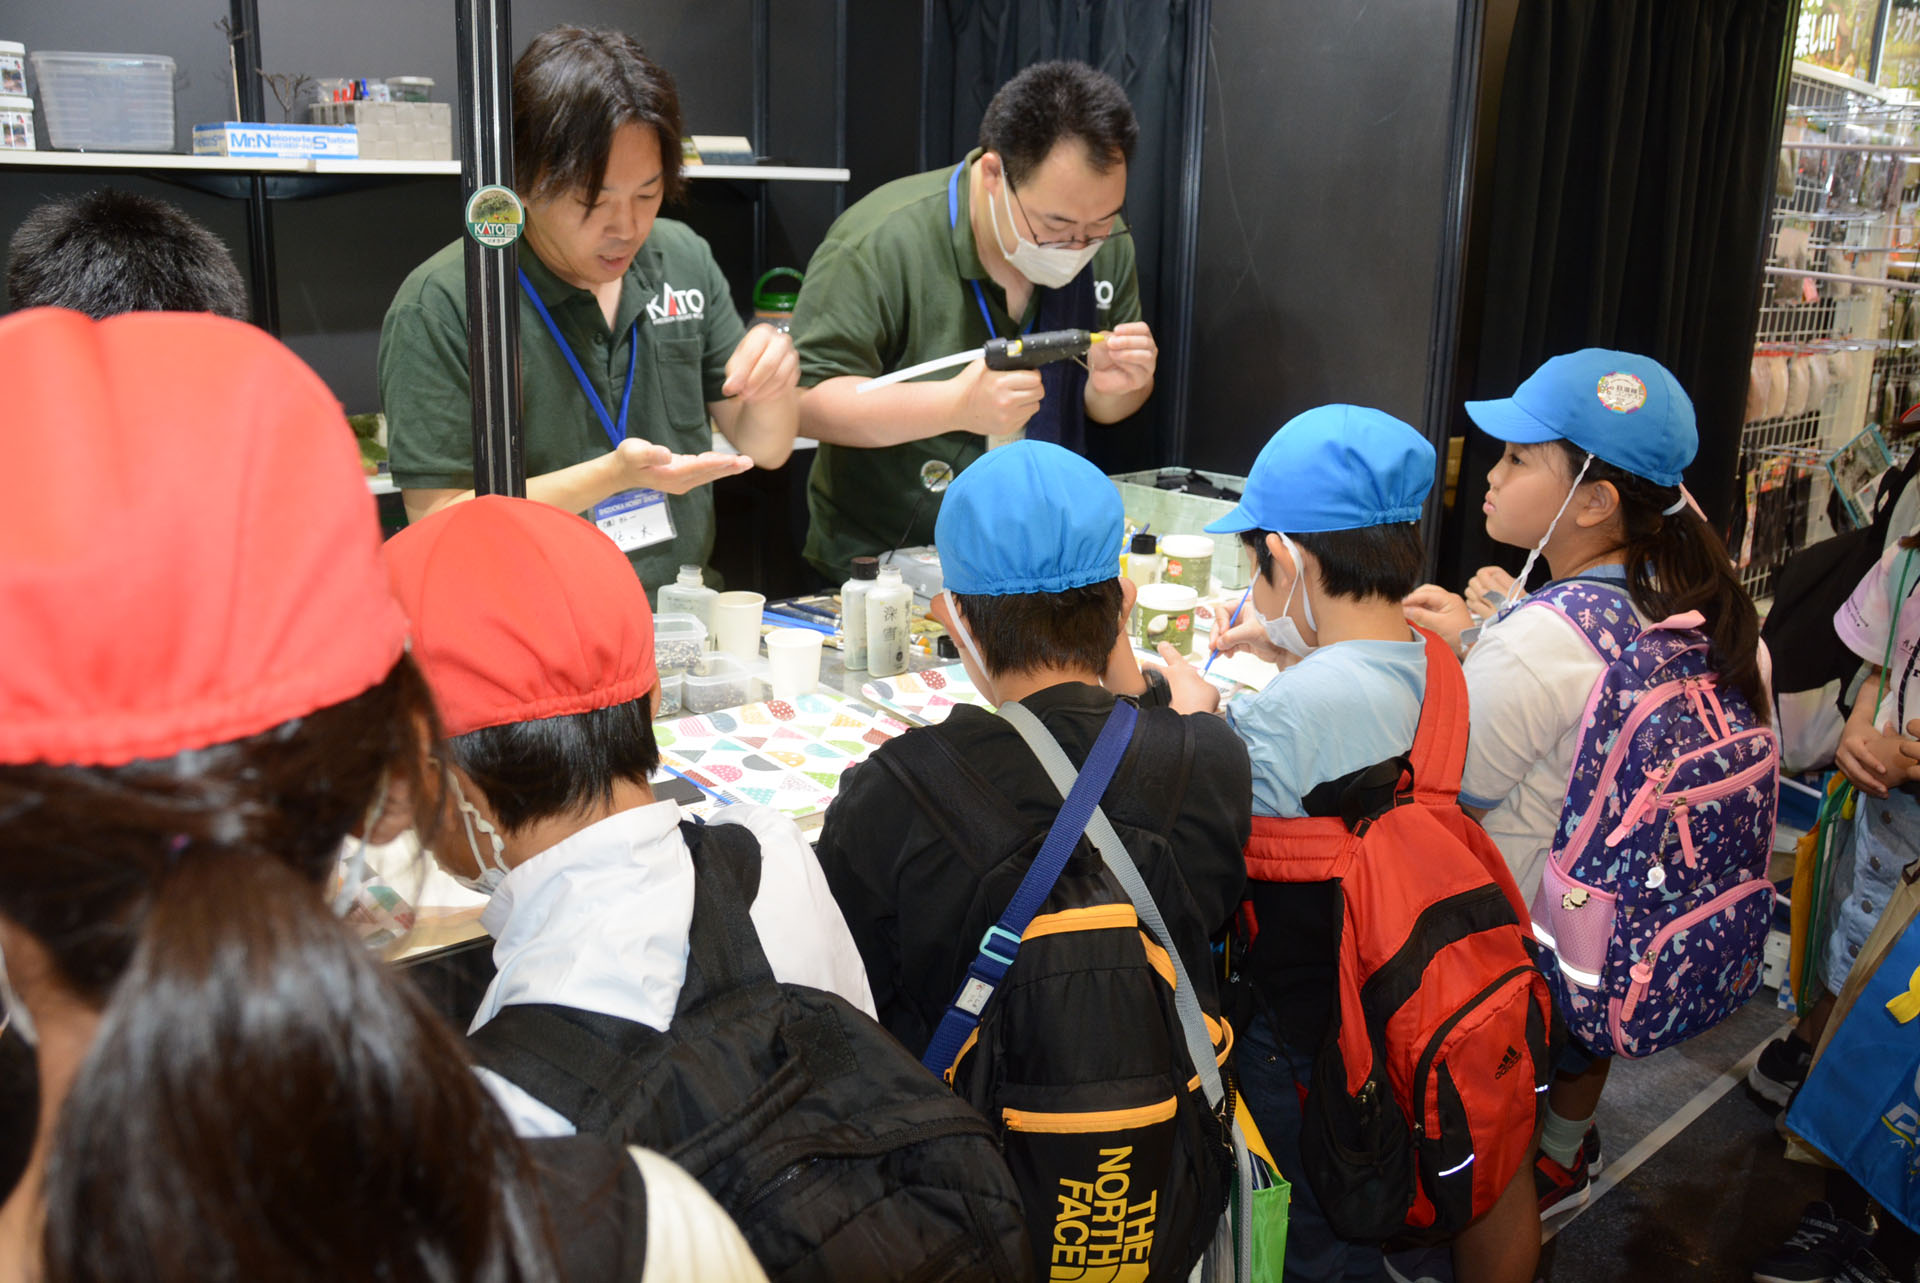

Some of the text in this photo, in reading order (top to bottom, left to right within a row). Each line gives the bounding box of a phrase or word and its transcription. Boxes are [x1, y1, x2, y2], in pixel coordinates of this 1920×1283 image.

[474, 219, 504, 235] KATO
[646, 282, 705, 320] KATO
[1051, 1177, 1095, 1266] FACE
[1087, 1145, 1133, 1266] NORTH
[1121, 1189, 1158, 1262] THE
